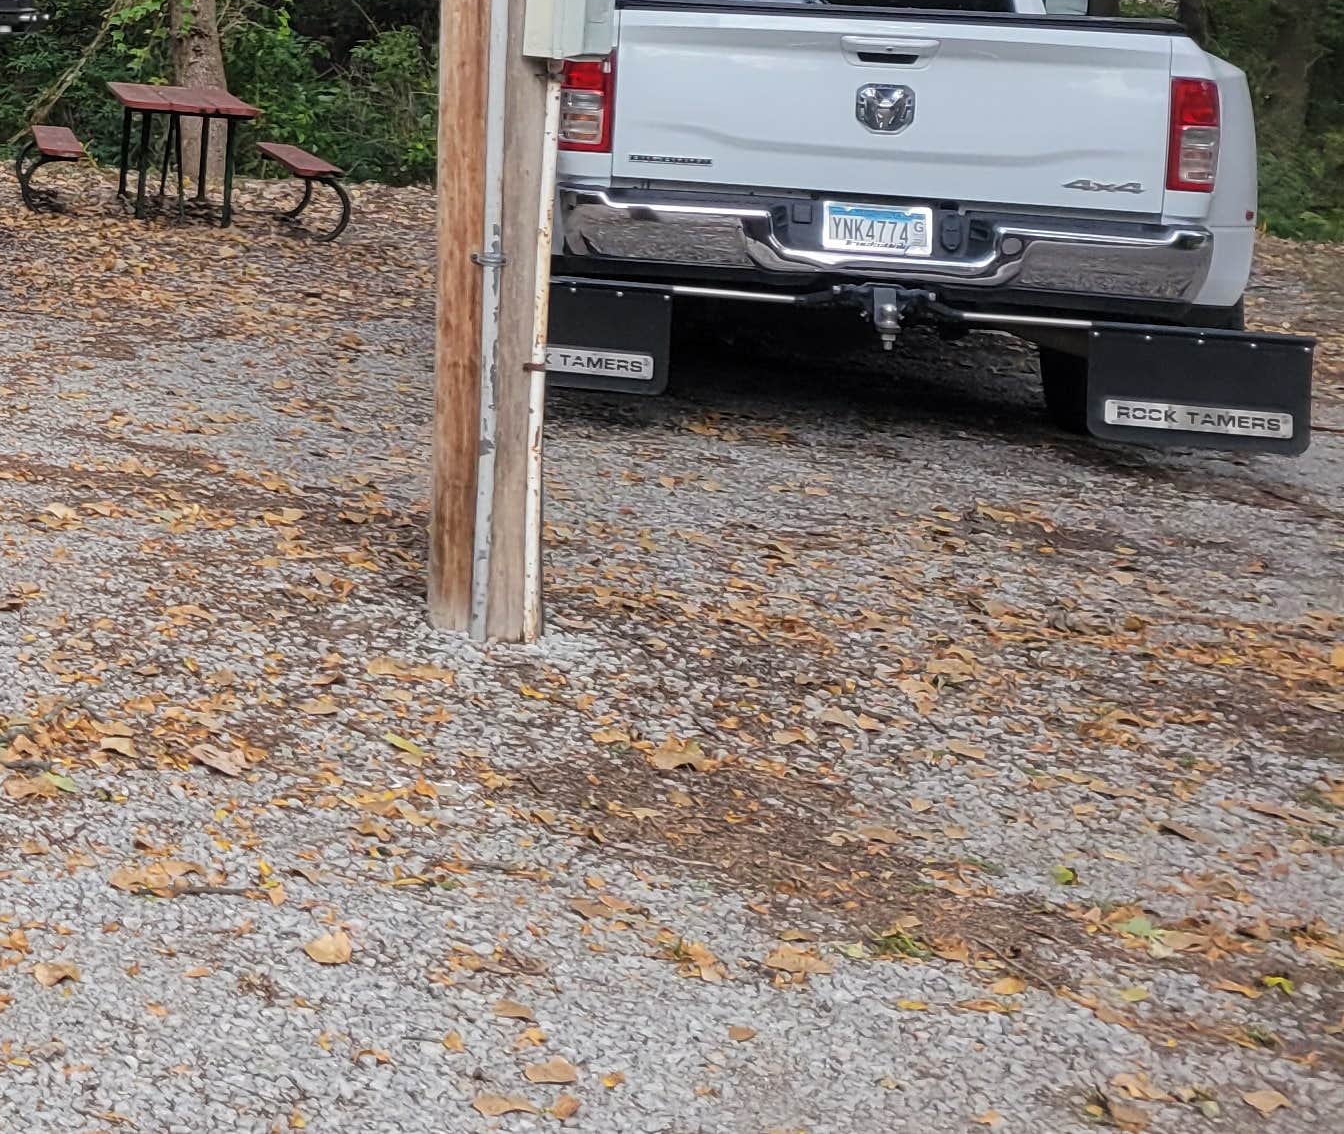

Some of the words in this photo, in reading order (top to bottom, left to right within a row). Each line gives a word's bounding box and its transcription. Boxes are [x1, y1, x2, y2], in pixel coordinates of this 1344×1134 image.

[832, 216, 910, 244] YNK4774
[559, 353, 643, 373] TAMERS
[1116, 405, 1178, 424] ROCK
[1185, 411, 1282, 432] TAMERS
